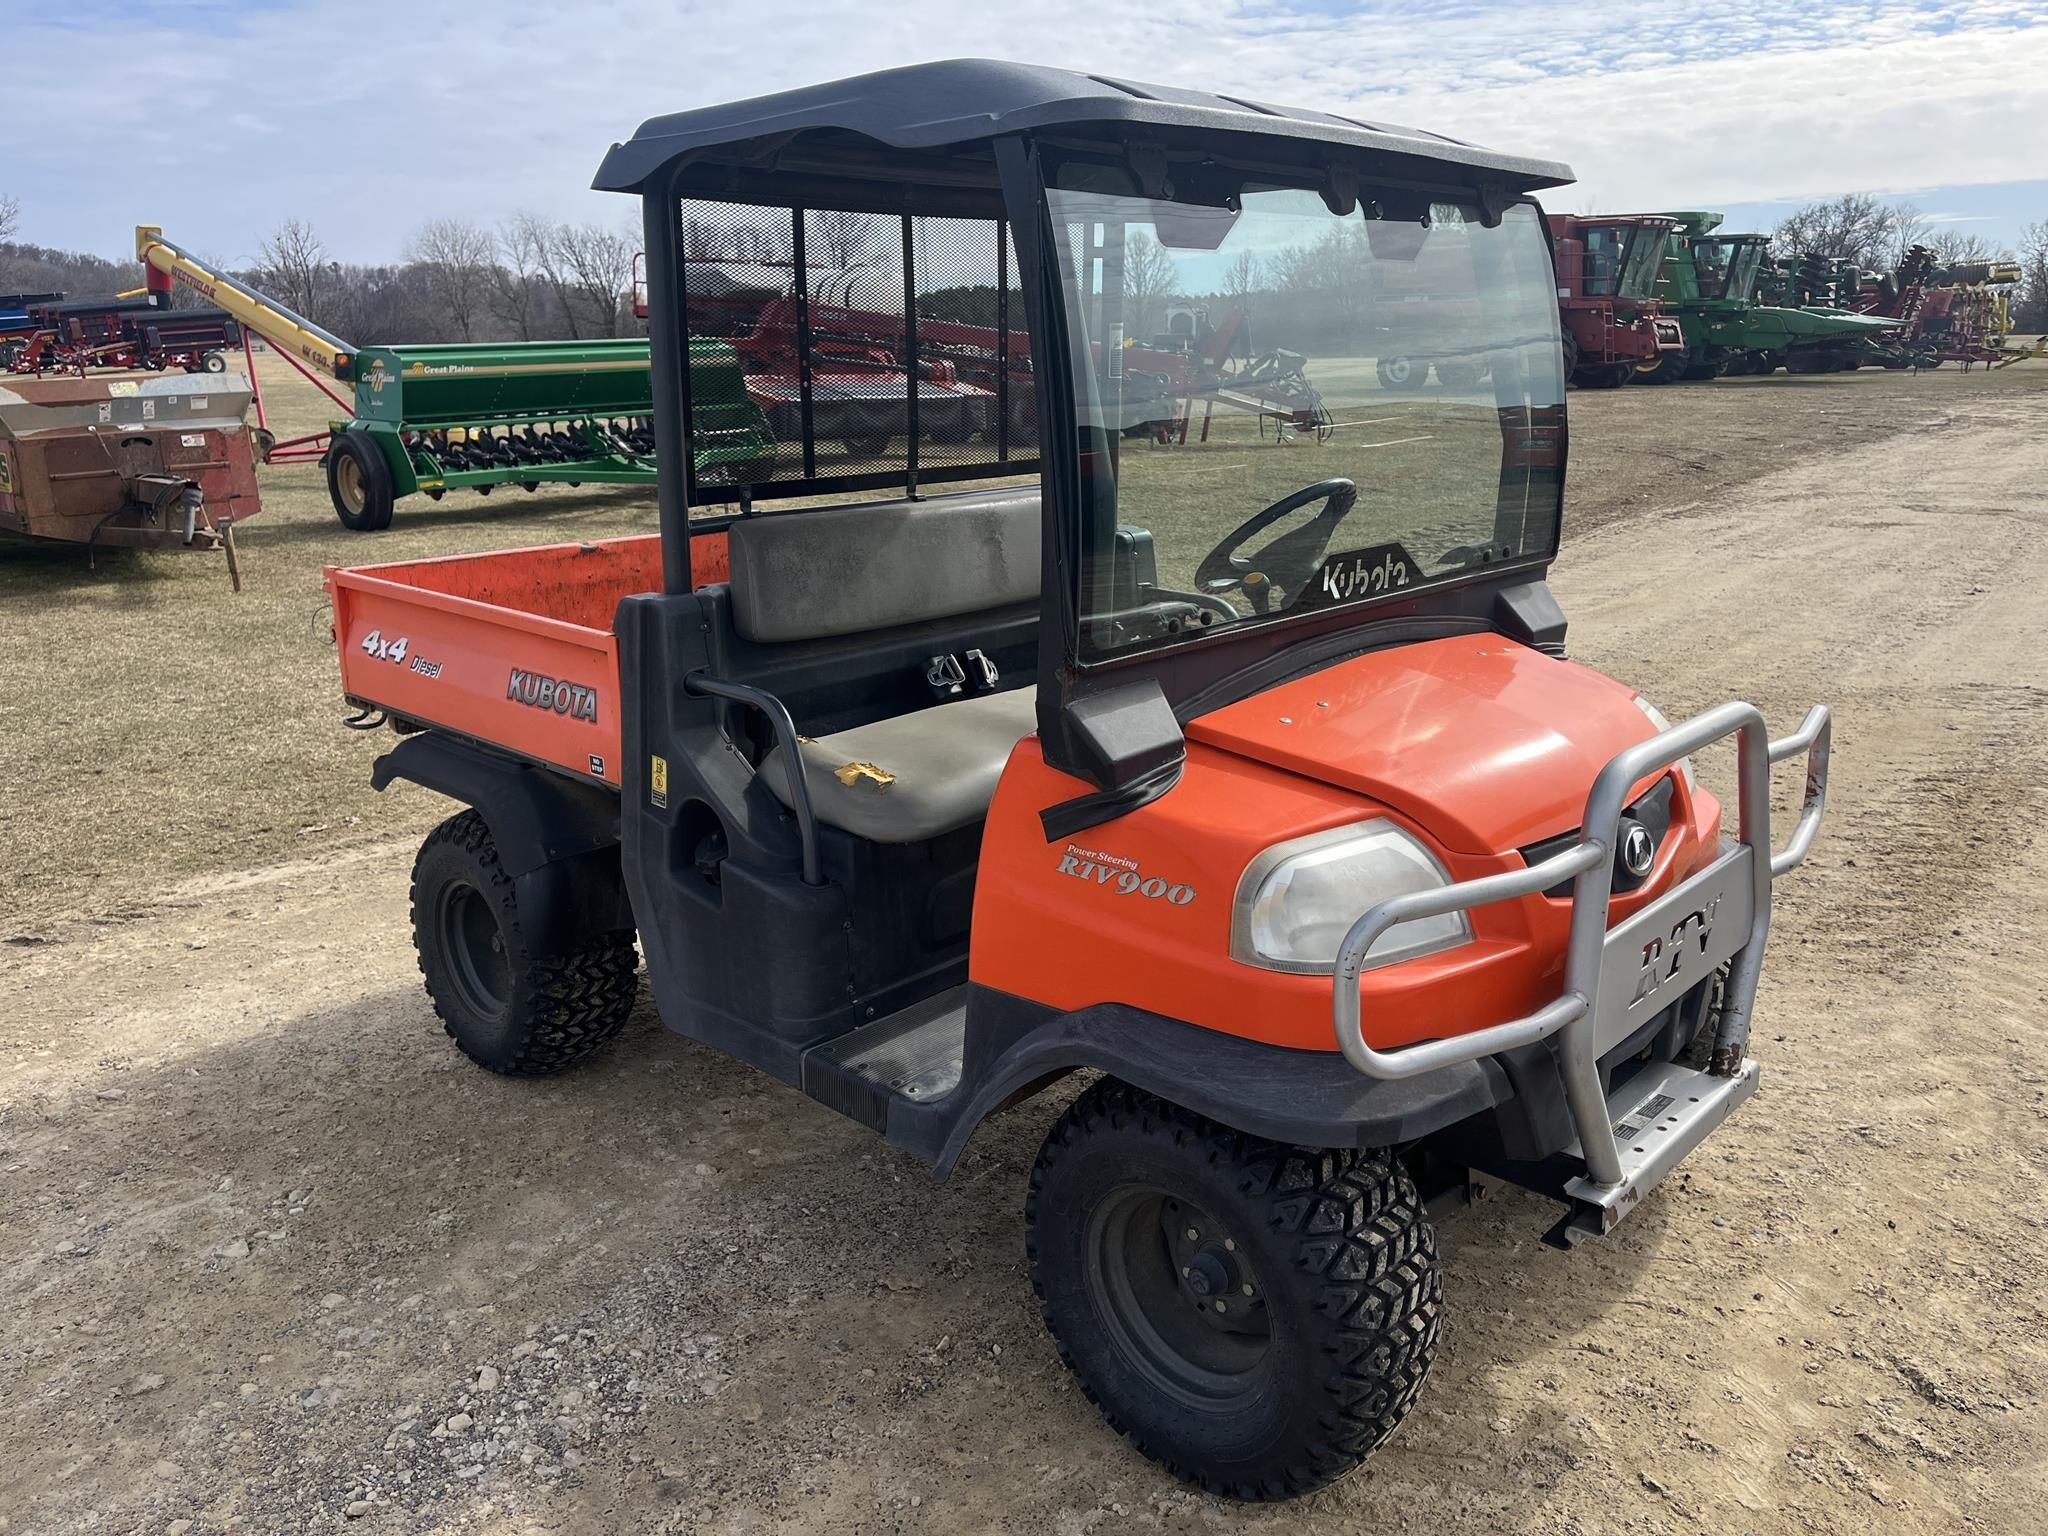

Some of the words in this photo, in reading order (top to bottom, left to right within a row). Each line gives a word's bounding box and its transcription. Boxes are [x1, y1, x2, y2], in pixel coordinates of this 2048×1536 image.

[171, 264, 210, 295] WESTFIELD
[424, 366, 447, 374] Great
[449, 364, 474, 373] Plains
[362, 630, 408, 664] 4x4
[410, 655, 443, 679] Diesel
[506, 667, 598, 724] KUBOTA
[591, 764, 603, 772] STEP
[592, 757, 600, 765] NO
[1067, 843, 1097, 858] Power
[1097, 851, 1139, 870] Steering
[1055, 853, 1196, 905] RTV900
[1627, 892, 1724, 1010] RTV
